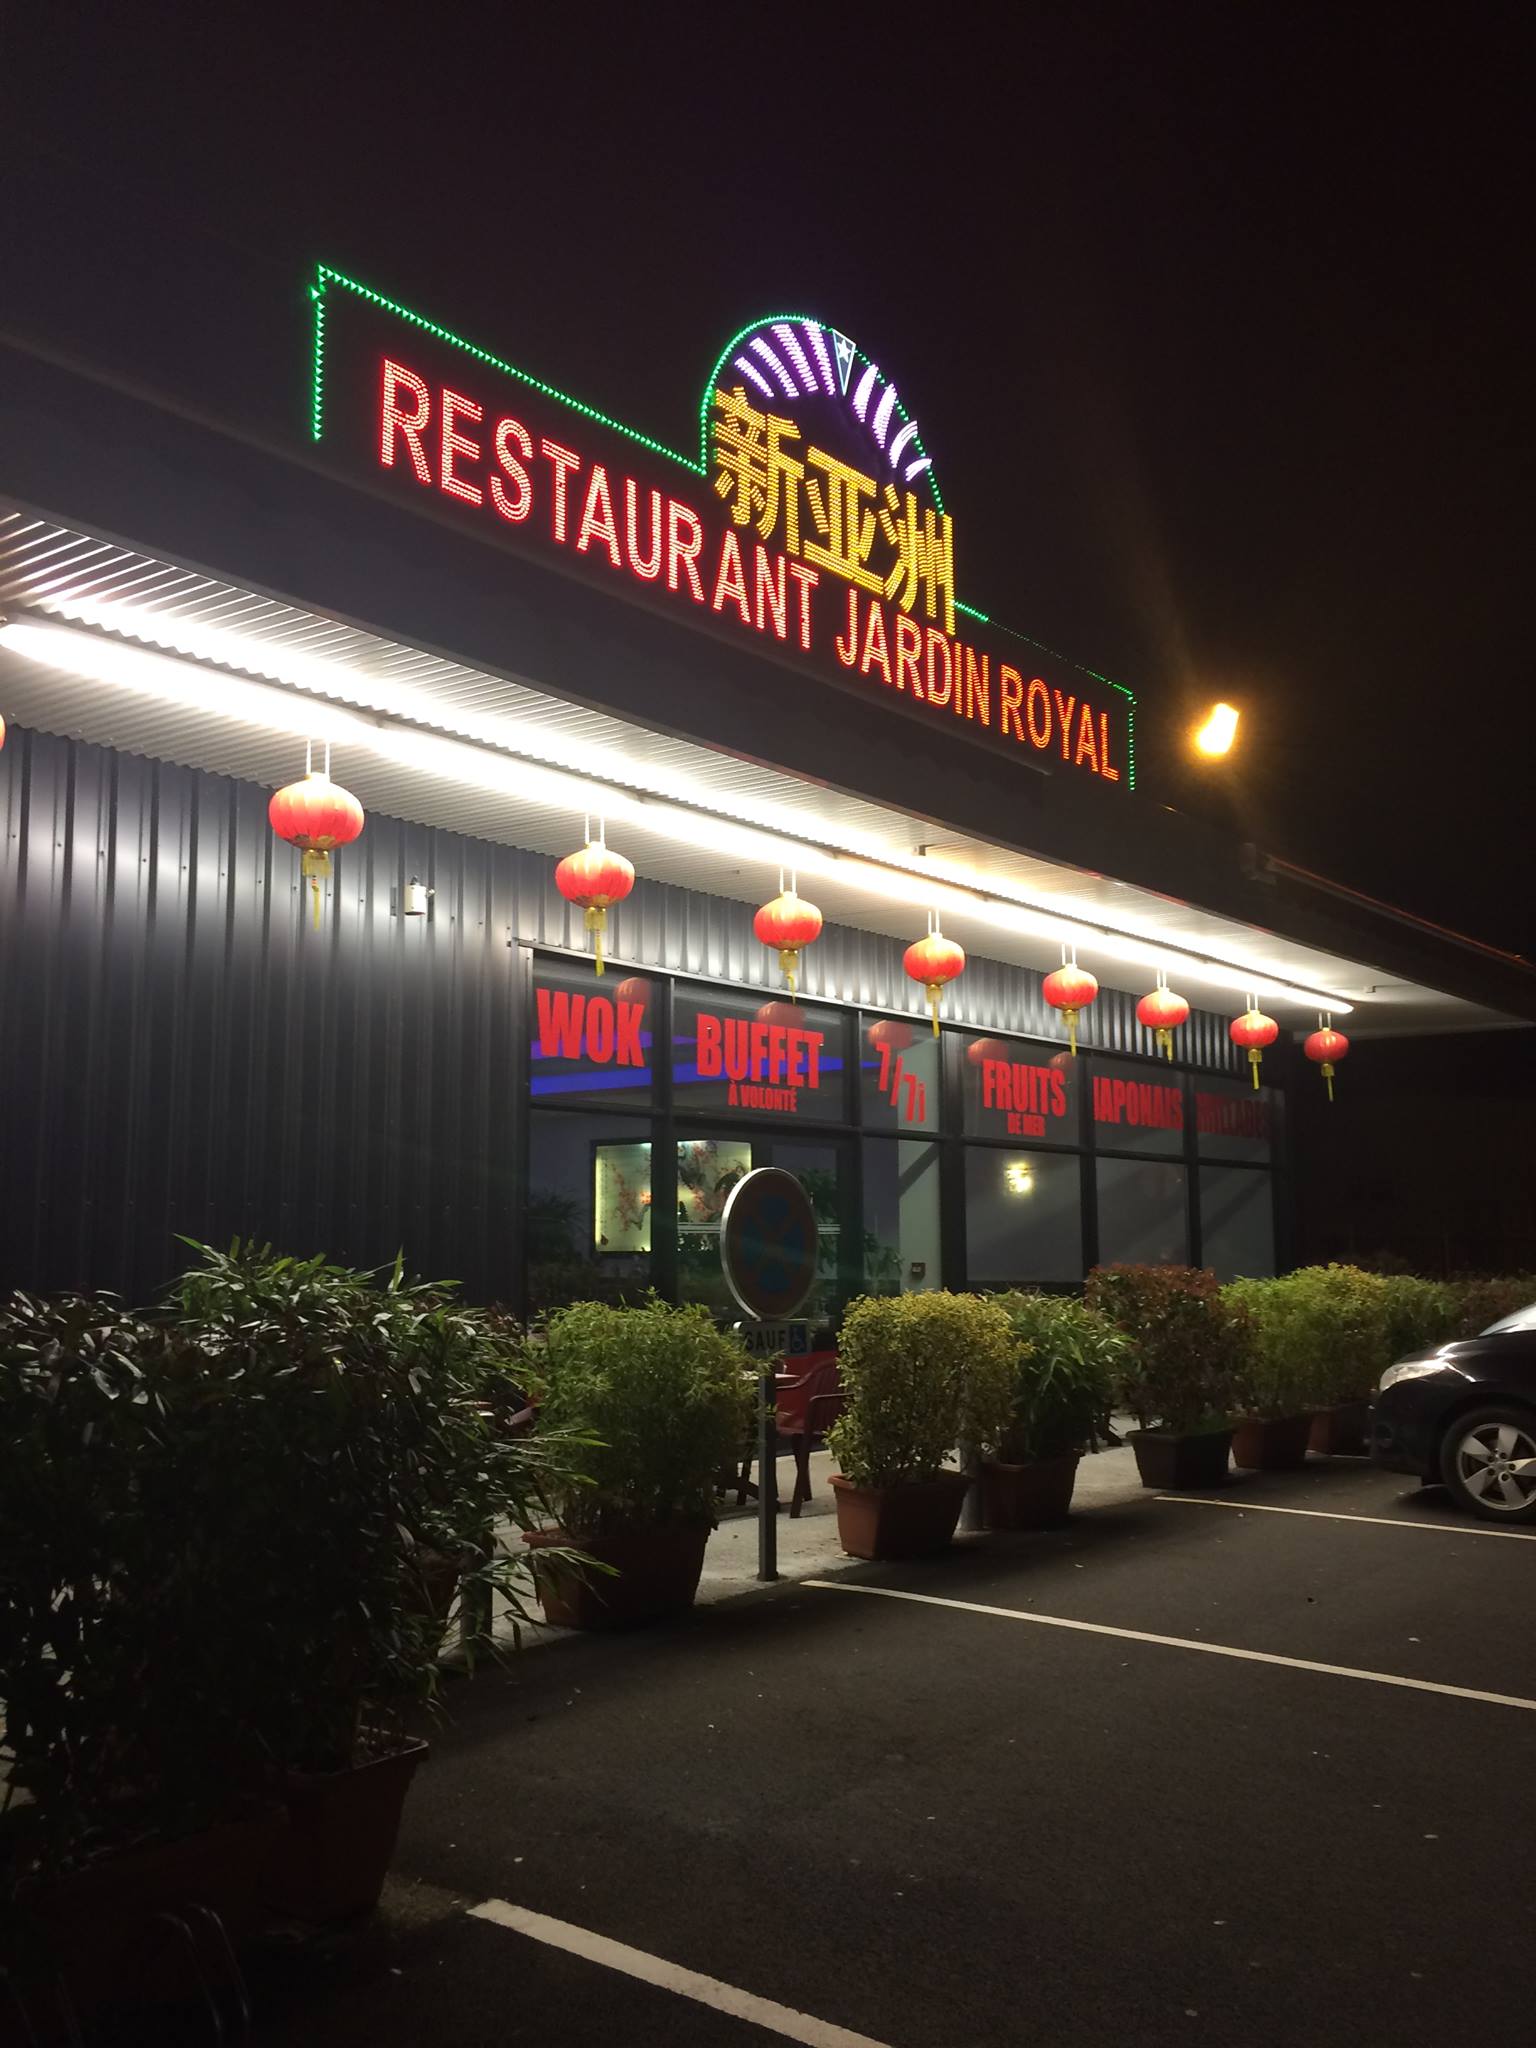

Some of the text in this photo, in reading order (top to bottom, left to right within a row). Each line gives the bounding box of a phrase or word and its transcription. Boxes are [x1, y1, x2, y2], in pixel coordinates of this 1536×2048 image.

[713, 386, 955, 636] 新亚洲
[379, 357, 1121, 782] RESTAURANT JARDIN ROYAL
[536, 988, 646, 1068] WOK
[696, 1012, 825, 1089] BUFFET
[982, 1059, 1067, 1117] FRUITS
[1007, 1113, 1022, 1135] DE
[746, 1330, 785, 1350] SAUF
